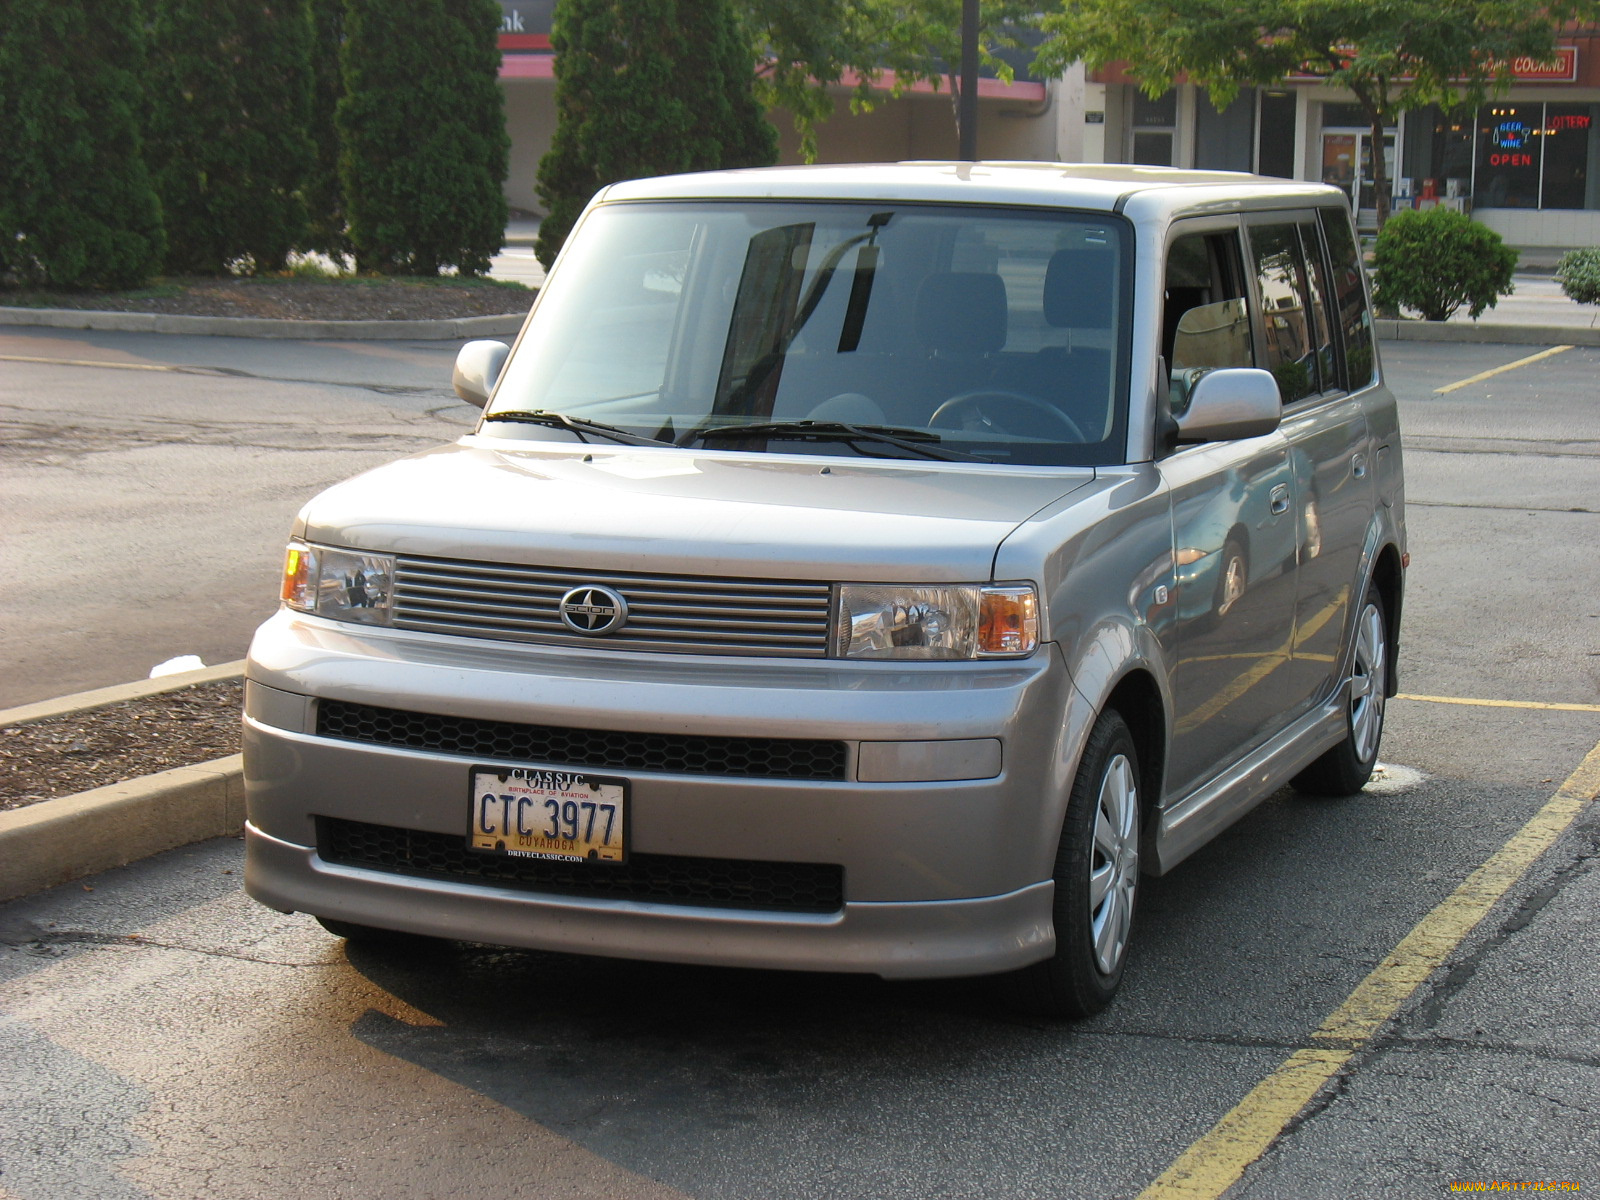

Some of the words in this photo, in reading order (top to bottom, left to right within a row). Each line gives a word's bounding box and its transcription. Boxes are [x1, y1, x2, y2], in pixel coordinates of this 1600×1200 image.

[1500, 121, 1521, 131] BEER
[1547, 116, 1590, 128] LOTTERY
[1500, 139, 1521, 148] WINE
[1490, 153, 1532, 166] OPEN
[511, 768, 584, 785] CLASSIC
[508, 786, 545, 796] BIRTHPLACE
[561, 791, 589, 799] AVIATION
[480, 793, 534, 837] CTC
[543, 798, 616, 846] 3977
[518, 836, 575, 851] CUYAHOGA
[507, 850, 583, 862] DRIVECLASSIC.COM
